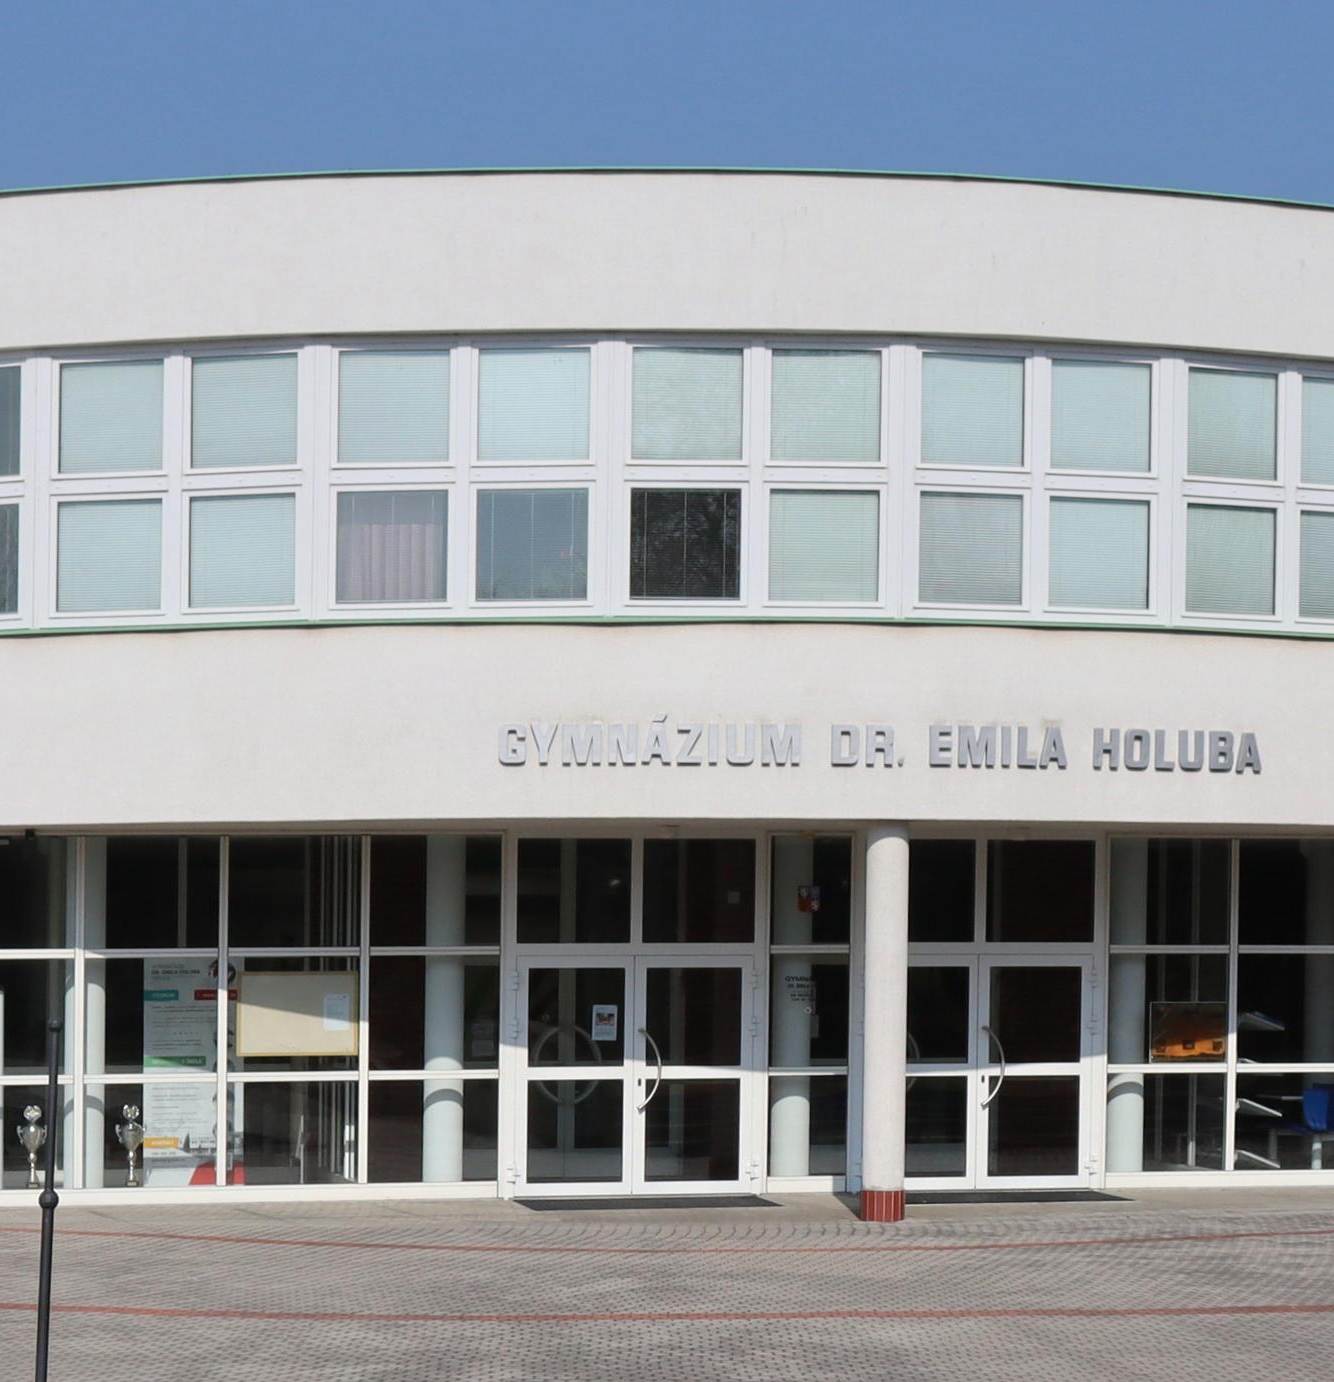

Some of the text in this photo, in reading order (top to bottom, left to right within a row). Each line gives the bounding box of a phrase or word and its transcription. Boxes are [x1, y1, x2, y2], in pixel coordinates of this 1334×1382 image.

[498, 713, 1263, 774] GYMNÁZIUM DR. EMILA HOLUBA
